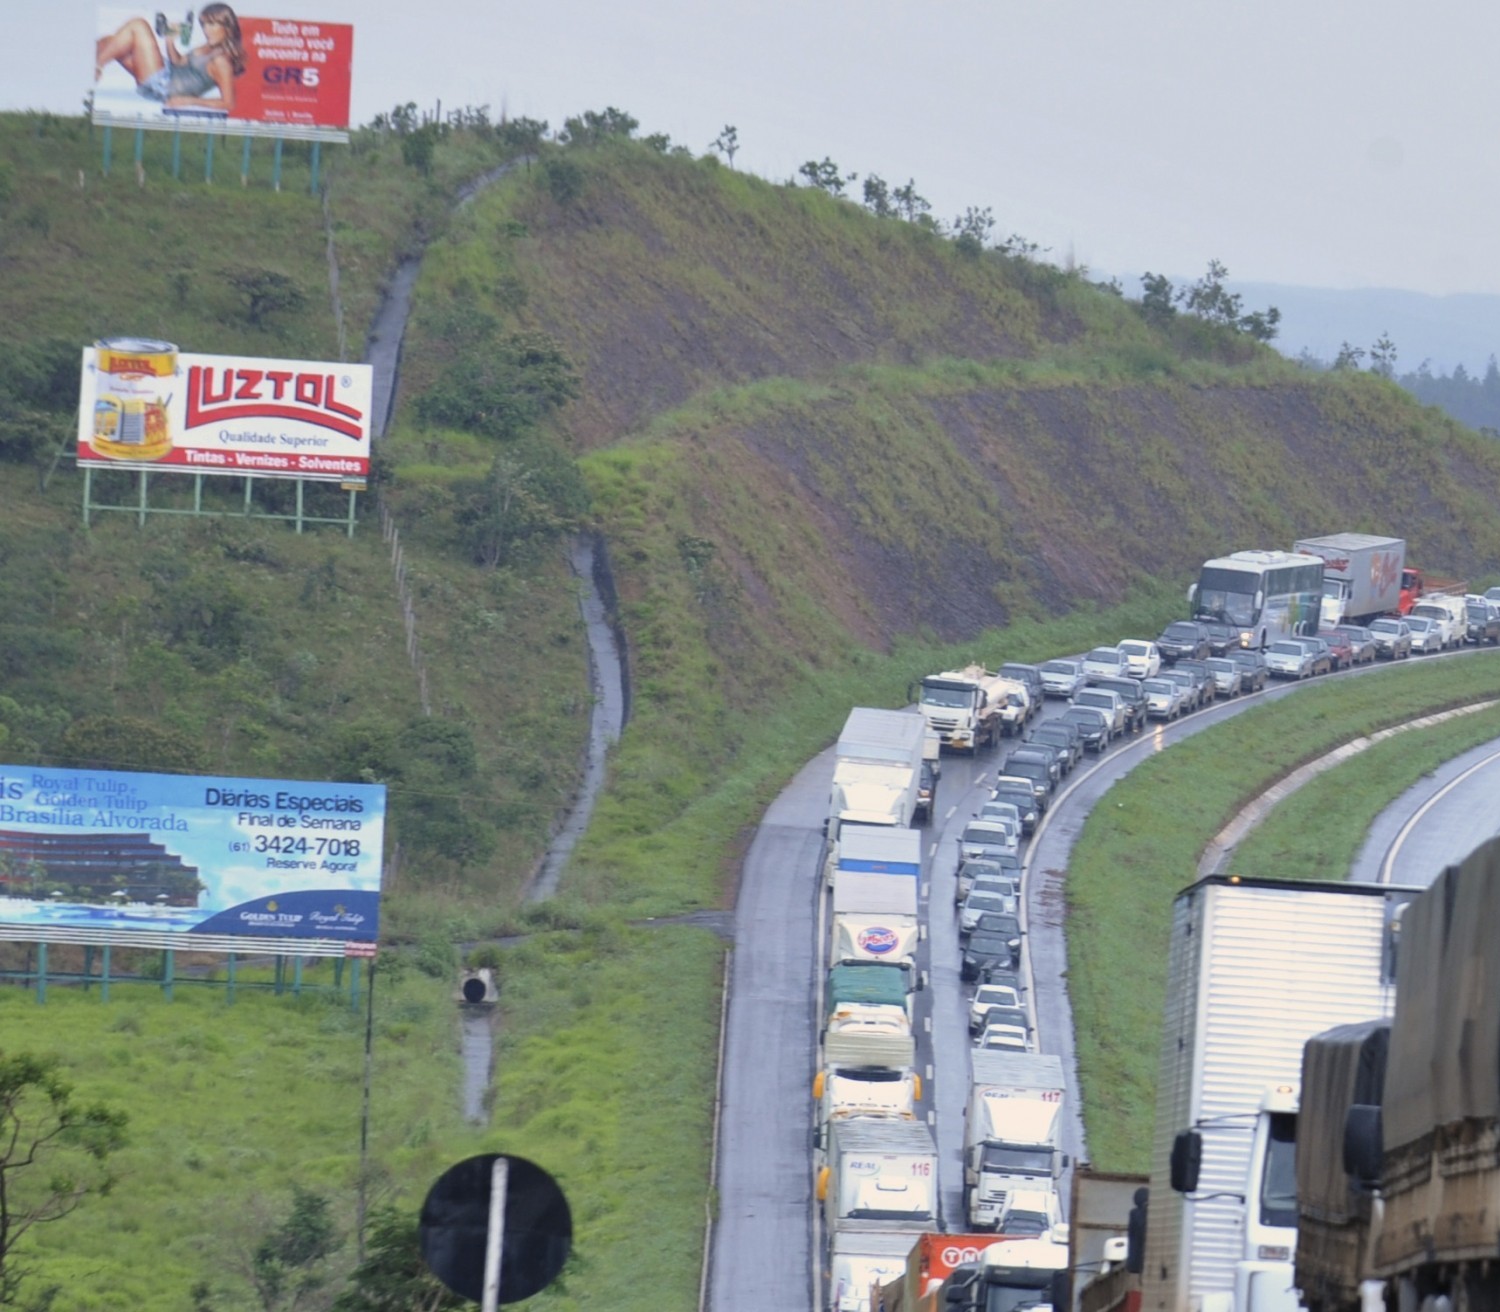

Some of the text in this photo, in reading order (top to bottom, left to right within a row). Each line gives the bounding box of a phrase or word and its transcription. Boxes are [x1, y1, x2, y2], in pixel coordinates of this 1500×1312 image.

[301, 26, 320, 36] em
[311, 53, 327, 63] na
[263, 65, 320, 87] GR5
[185, 365, 363, 441] LUZTOL
[219, 430, 329, 452] Qualidade Superior
[185, 450, 226, 464] Tintas
[235, 453, 288, 467] Vernizes
[298, 456, 361, 472] Solventes
[32, 774, 78, 791] Royal
[85, 778, 128, 795] Tulip
[35, 791, 148, 813] Golden Tulip
[205, 787, 364, 815] Diárias Especiais
[92, 811, 189, 832] Alvorada
[238, 812, 361, 831] Final de Semana
[229, 834, 361, 857] (61) 3424-7018
[266, 857, 317, 870] Reserve
[1041, 1092, 1060, 1103] 117
[912, 1163, 930, 1176] 116
